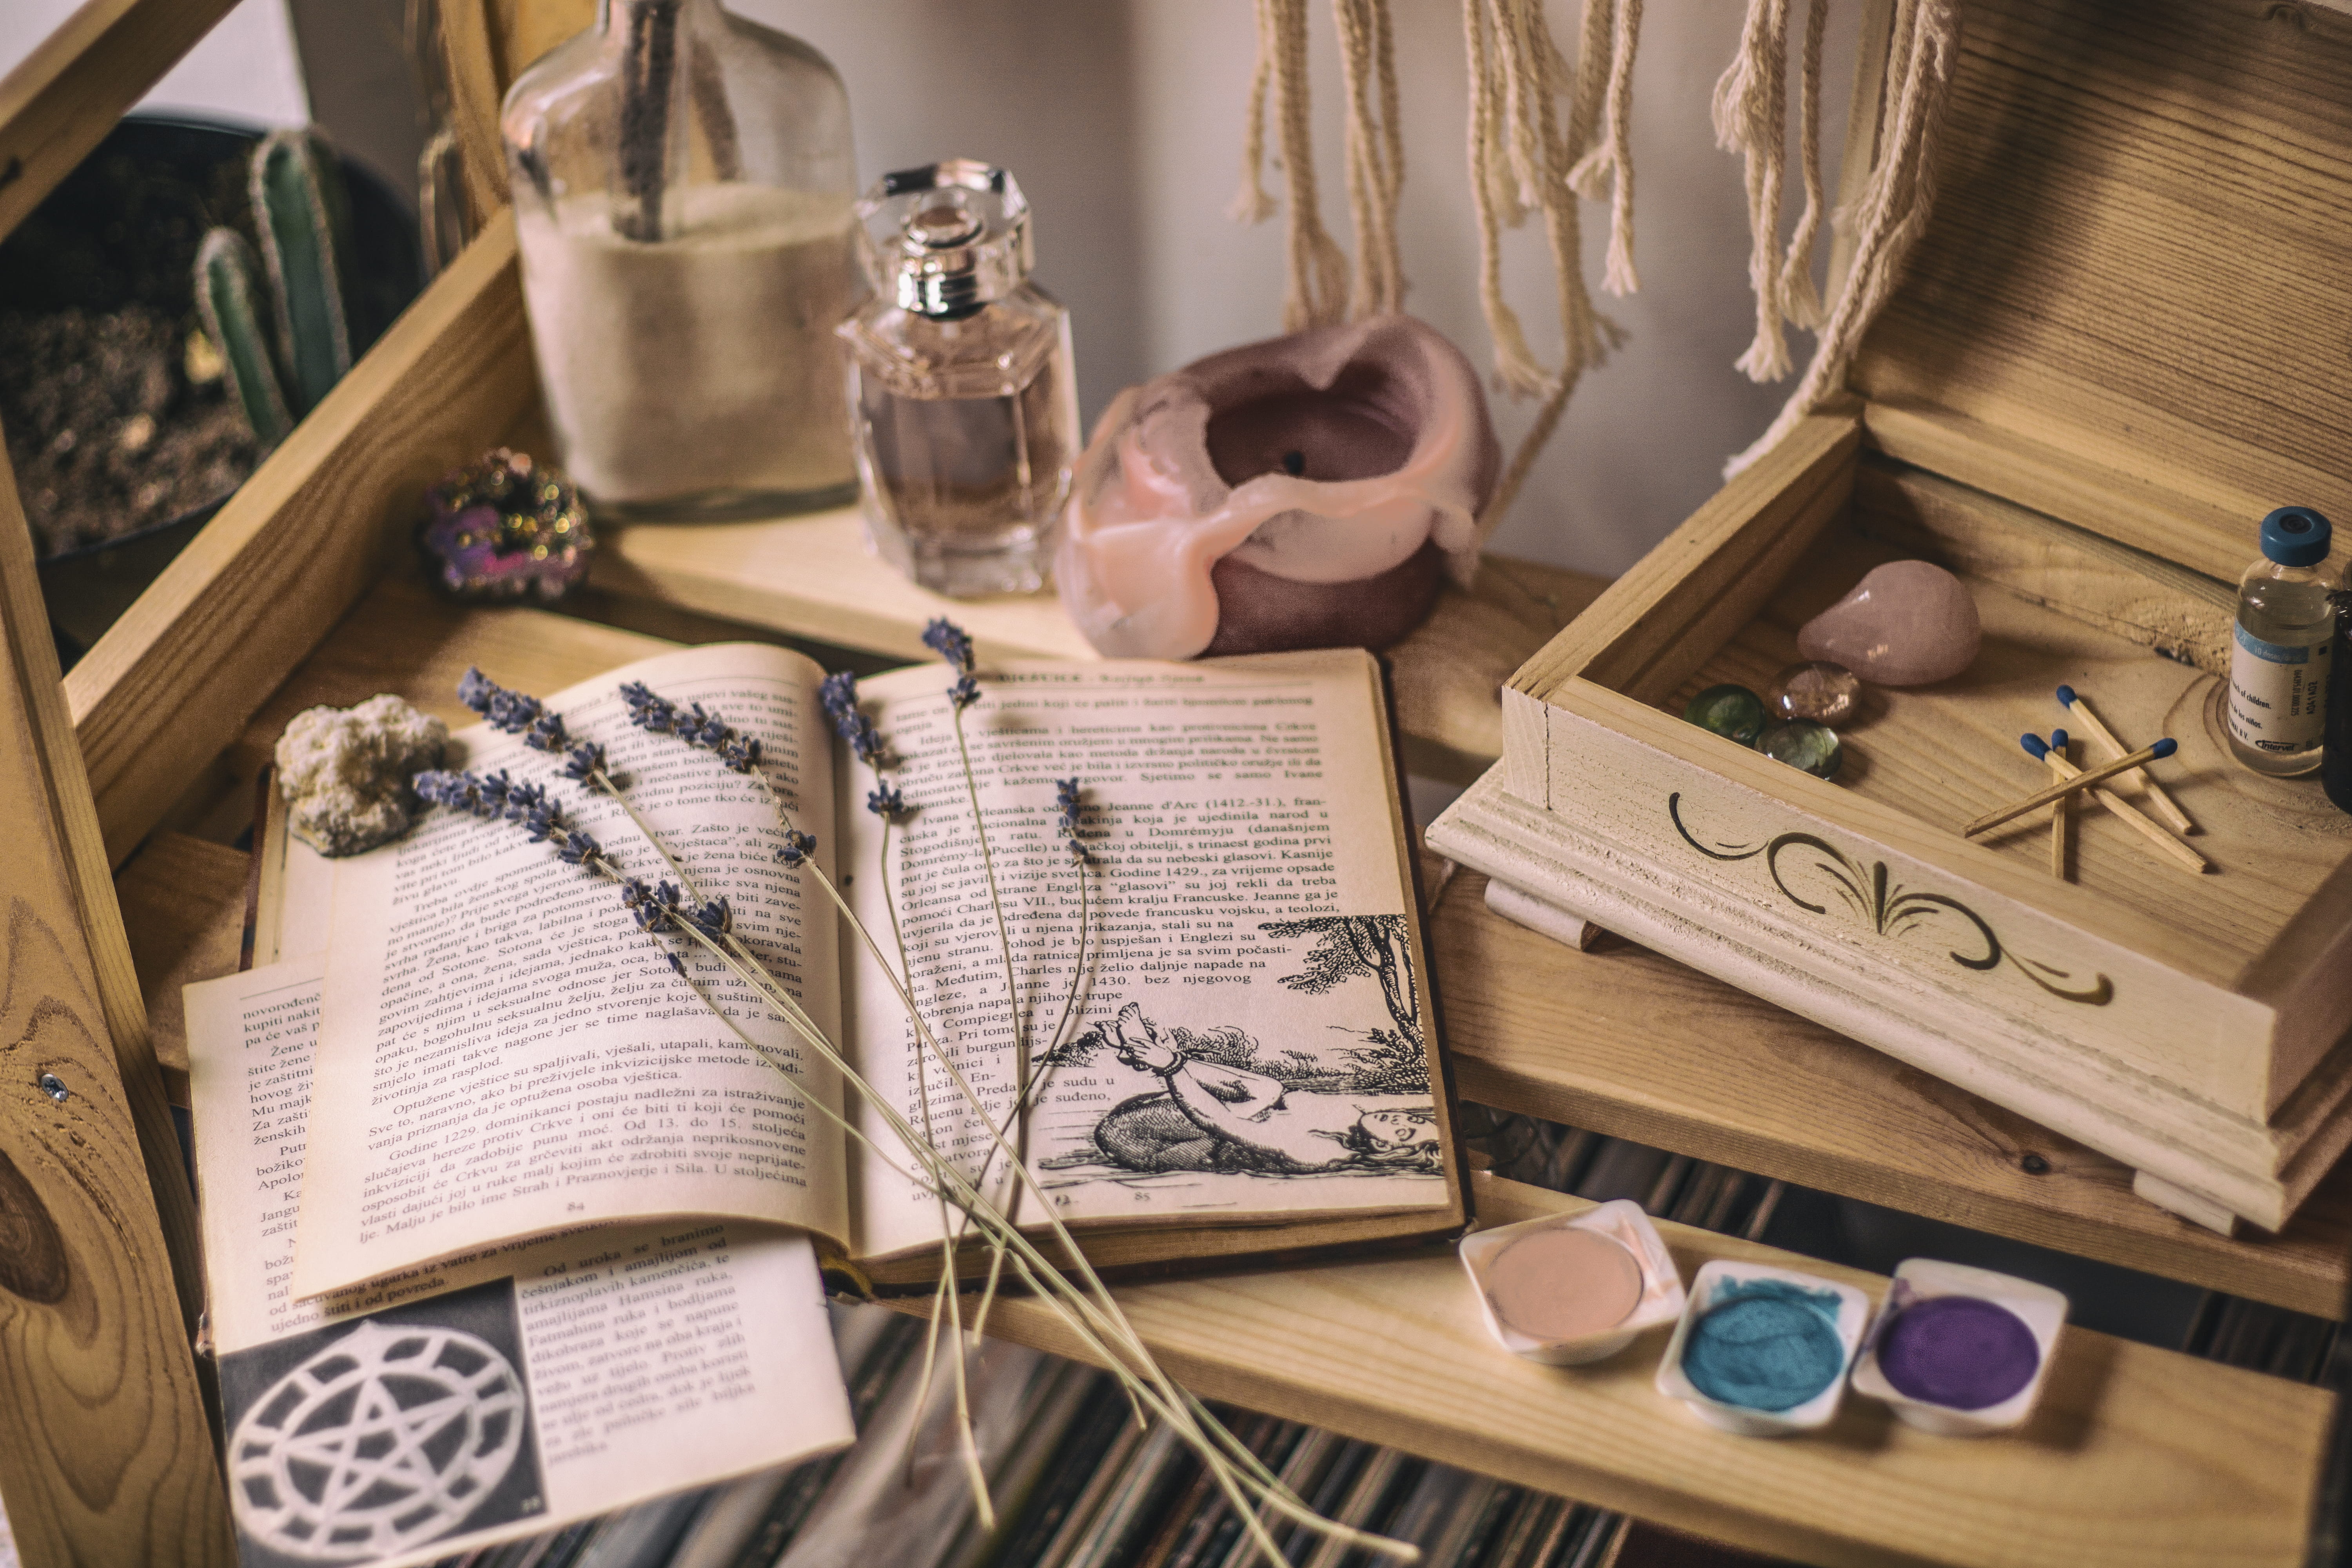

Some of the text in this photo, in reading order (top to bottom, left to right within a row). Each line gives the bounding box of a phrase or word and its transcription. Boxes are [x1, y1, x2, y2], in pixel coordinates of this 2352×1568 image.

[2247, 693, 2271, 710] children.
[2246, 717, 2263, 730] niños.
[922, 813, 959, 825] Ivana
[1107, 801, 1154, 811] Jeanne
[902, 889, 915, 899] su
[918, 881, 936, 897] joj
[941, 881, 955, 890] se
[1000, 871, 1005, 881] i
[1009, 869, 1047, 882] vizije
[1109, 867, 1161, 877] Godine
[1166, 866, 1208, 877] 1429.,
[1230, 864, 1283, 877] vrijeme
[1286, 862, 1335, 875] opsade
[902, 894, 961, 911] Orleansa
[969, 887, 987, 898] od
[996, 885, 1037, 896] strane
[1110, 880, 1175, 893] “glasovi”
[1208, 879, 1227, 892] joj
[1236, 877, 1268, 888] rekli
[1276, 877, 1293, 887] da
[1301, 875, 1337, 886] treba
[902, 906, 952, 929] pomoći
[1128, 893, 1169, 906] kralju
[1173, 891, 1248, 903] Francuske.
[1253, 891, 1300, 901] Jeanne
[1306, 893, 1320, 902] ga
[1325, 889, 1338, 902] je
[903, 920, 954, 939] uvjerila
[959, 917, 975, 927] da
[980, 915, 993, 927] je
[1068, 909, 1082, 918] da
[1090, 907, 1140, 921] povede
[1145, 906, 1214, 917] francusku
[1218, 904, 1269, 918] vojsku,
[1287, 902, 1339, 913] teolozi,
[904, 938, 929, 953] koji
[934, 937, 949, 946] su
[1035, 923, 1074, 936] njena
[1161, 919, 1190, 930] stali
[948, 945, 993, 957] stranu.
[1051, 936, 1064, 949] je
[1102, 934, 1161, 947] uspješan
[1168, 933, 1173, 943] i
[1181, 931, 1233, 945] Englezi
[1033, 950, 1080, 961] ratnica
[1086, 948, 1154, 962] primljena
[1158, 947, 1171, 960] je
[1197, 945, 1231, 955] svim
[1236, 943, 1292, 958] počasti-
[379, 944, 624, 1024] govim zahtjevima i idejama, jednako
[477, 960, 616, 1003] idejama svoga muža,
[936, 970, 1002, 987] Međutim,
[1100, 962, 1134, 972] želio
[1140, 960, 1188, 973] daljnje
[1194, 958, 1243, 972] napade
[1092, 975, 1130, 985] 1430.
[1144, 974, 1170, 984] bez
[1183, 973, 1252, 986] njegovog
[245, 1007, 320, 1033] kupiti nakit
[245, 1022, 307, 1048] pa će vaš
[271, 1043, 304, 1057] Žene
[248, 1054, 310, 1076] štite žene
[393, 1090, 455, 1114] Optužene
[460, 1073, 509, 1094] vještice
[514, 1067, 528, 1077] su
[533, 1049, 599, 1073] spaljivali,
[605, 1041, 655, 1058] vješali,
[660, 1038, 713, 1051] utapali,
[248, 1080, 261, 1093] je
[250, 1087, 293, 1104] hovog
[369, 1053, 750, 1136] Sve to, naravno, ako bi preživjele inkvizicijske metode
[252, 1106, 275, 1117] Mu
[368, 1069, 681, 1150] vanja priznanja da je optužena osoba vještica.
[253, 1121, 270, 1131] Za
[254, 1125, 307, 1145] ženskih
[389, 1140, 437, 1160] Godine
[445, 1125, 478, 1143] 1229.
[485, 1100, 570, 1131] dominikanci
[577, 1092, 628, 1111] postaju
[634, 1086, 695, 1100] nadležni
[724, 1087, 804, 1110] istraživanje
[365, 1158, 425, 1183] slučajeva
[433, 1143, 475, 1161] hereze
[483, 1128, 522, 1149] protiv
[530, 1118, 572, 1133] Crkve
[592, 1107, 613, 1120] oni
[621, 1105, 637, 1116] će
[645, 1102, 668, 1113] biti
[677, 1102, 686, 1112] ti
[694, 1102, 721, 1114] koji
[728, 1103, 745, 1114] će
[753, 1109, 804, 1123] pomoći
